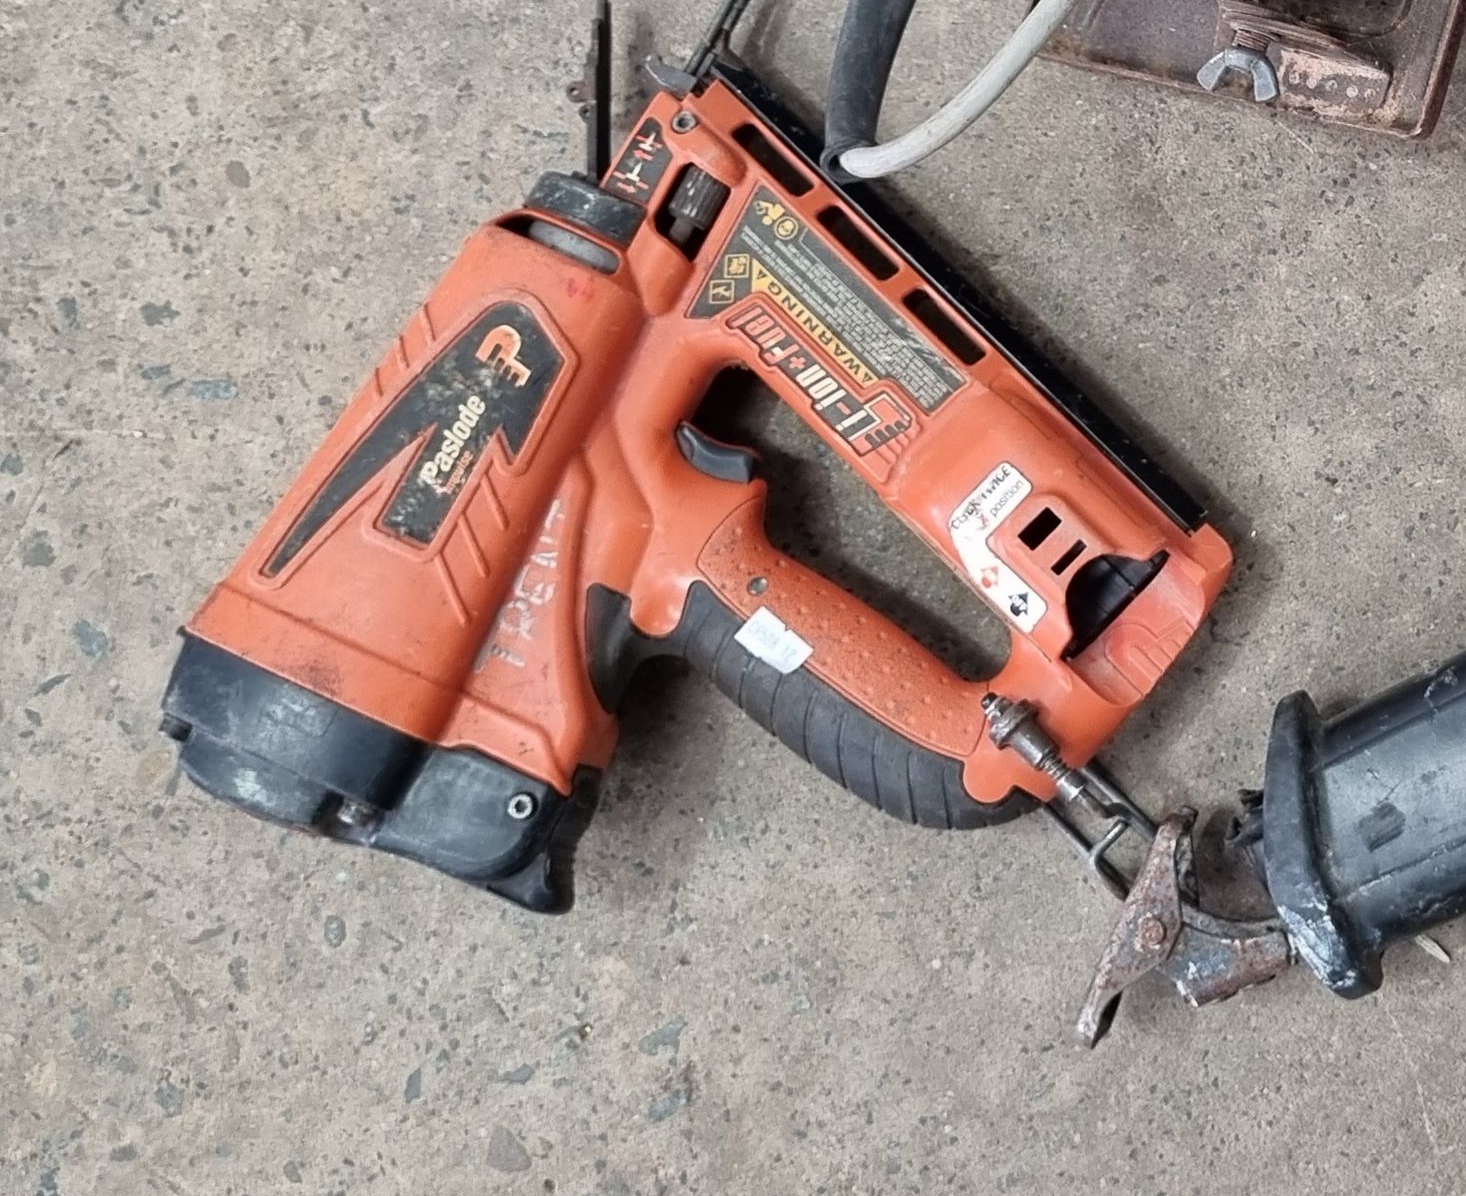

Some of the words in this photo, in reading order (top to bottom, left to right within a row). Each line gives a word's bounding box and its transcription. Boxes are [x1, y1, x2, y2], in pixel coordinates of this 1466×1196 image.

[767, 280, 863, 371] WARNING
[418, 394, 486, 485] Paslode
[989, 479, 1025, 519] position
